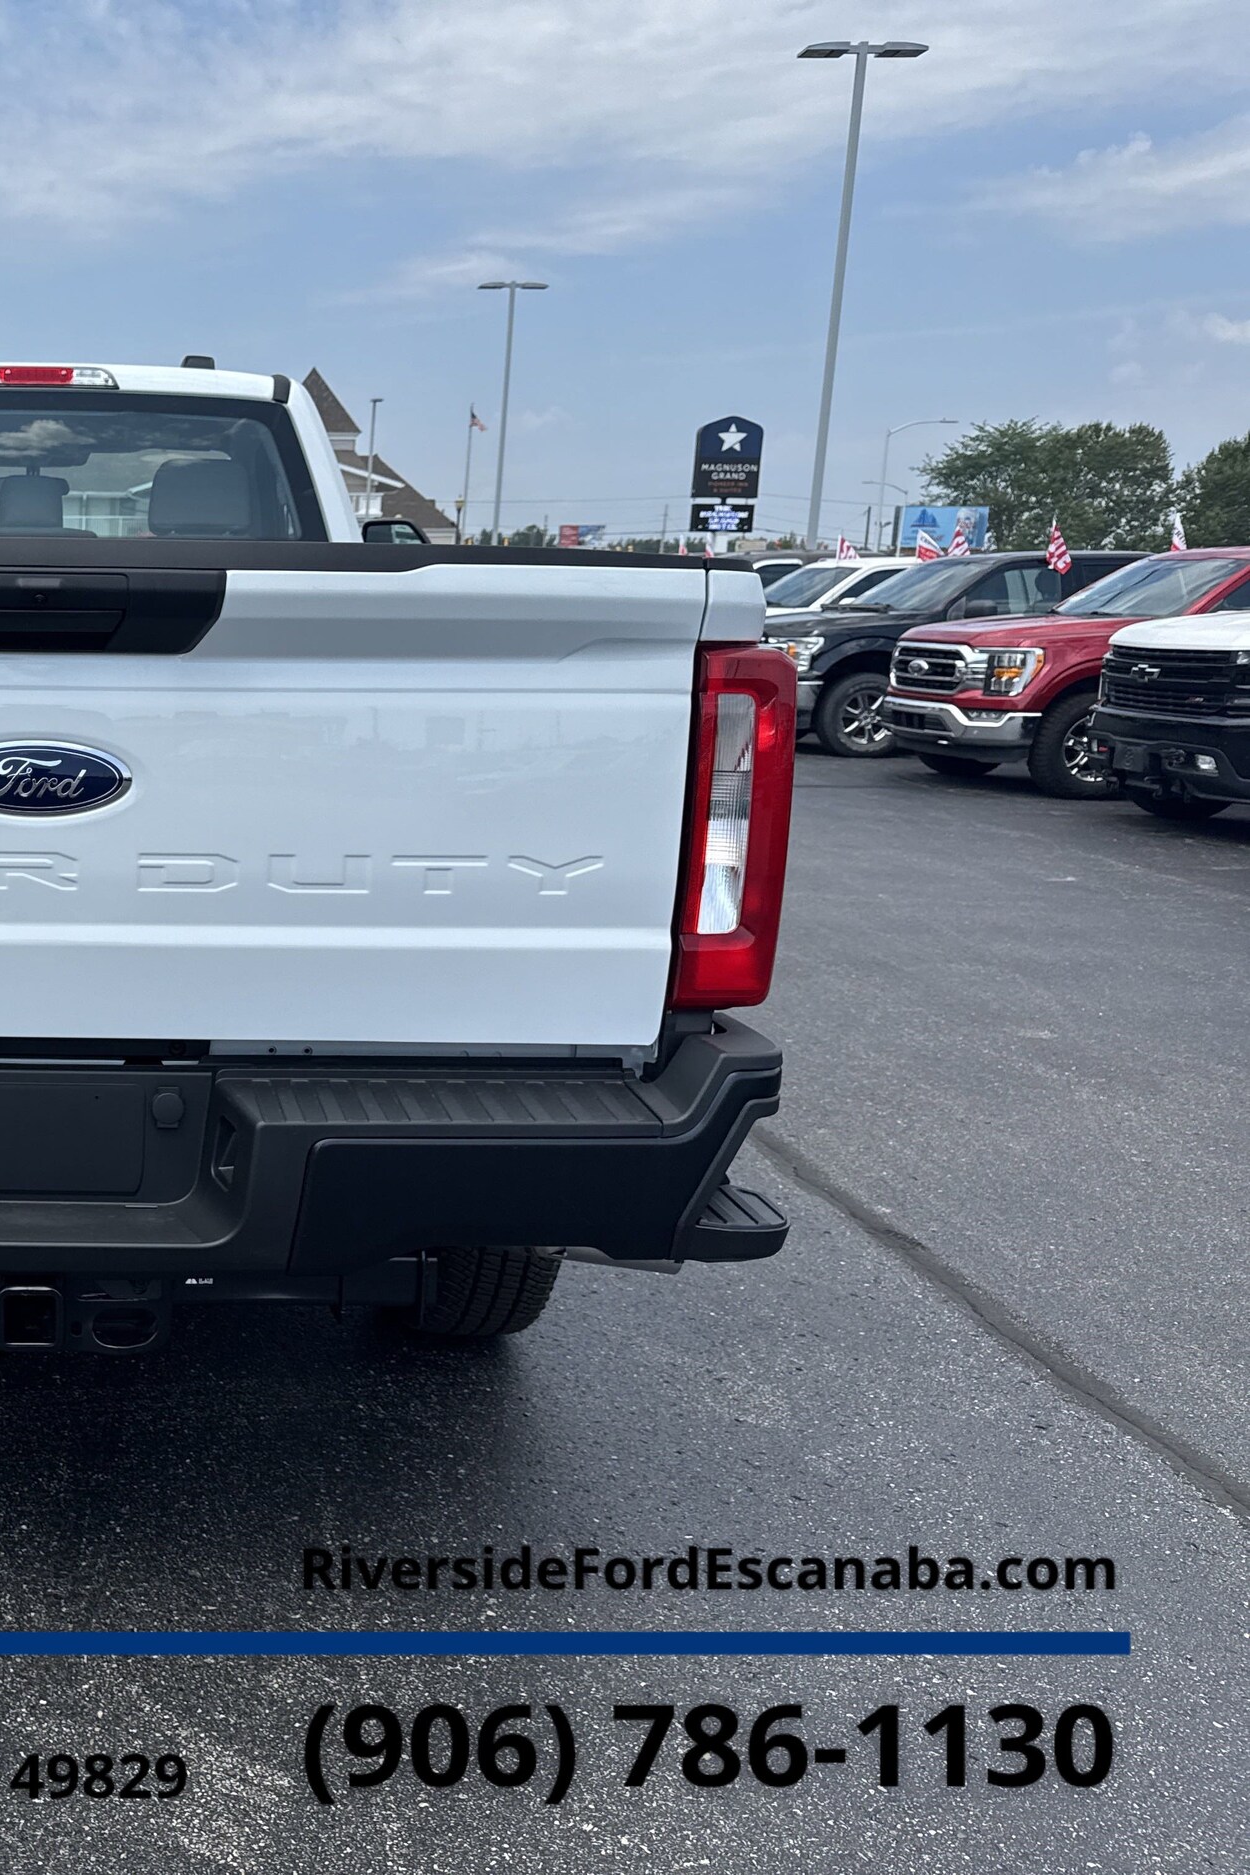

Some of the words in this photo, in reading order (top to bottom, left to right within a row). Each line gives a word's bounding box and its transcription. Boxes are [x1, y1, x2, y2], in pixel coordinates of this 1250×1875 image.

[701, 463, 759, 472] MAGNUSON
[711, 472, 747, 480] GRAND
[137, 852, 604, 896] DUTY
